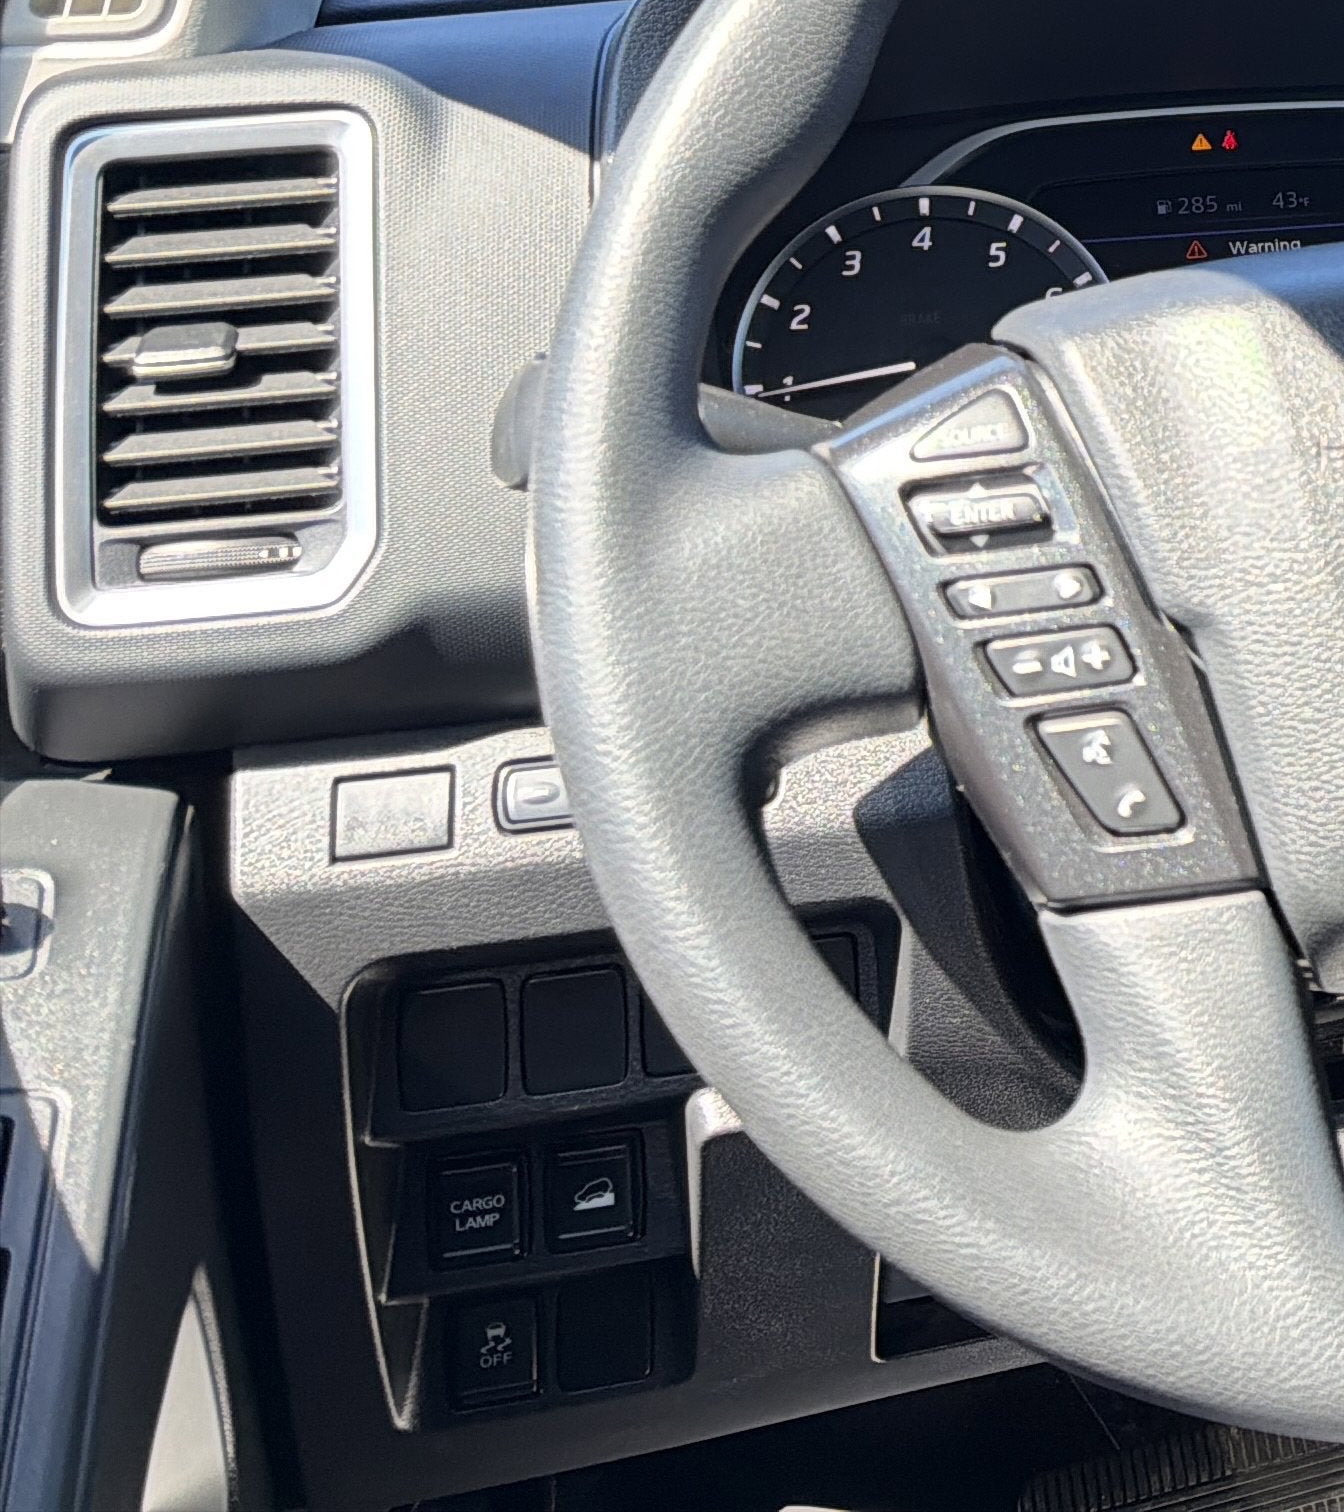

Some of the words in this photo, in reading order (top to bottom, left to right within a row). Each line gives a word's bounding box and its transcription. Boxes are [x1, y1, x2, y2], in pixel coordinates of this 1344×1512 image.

[1178, 195, 1218, 215] 285
[1226, 201, 1242, 213] mi
[912, 226, 932, 251] 4
[841, 250, 862, 276] 3
[988, 243, 1008, 269] 5
[789, 304, 811, 330] 2
[950, 499, 1015, 525] ENTER
[450, 1194, 505, 1214] CARGO
[455, 1213, 500, 1232] LAMP
[479, 1351, 513, 1368] OFF
